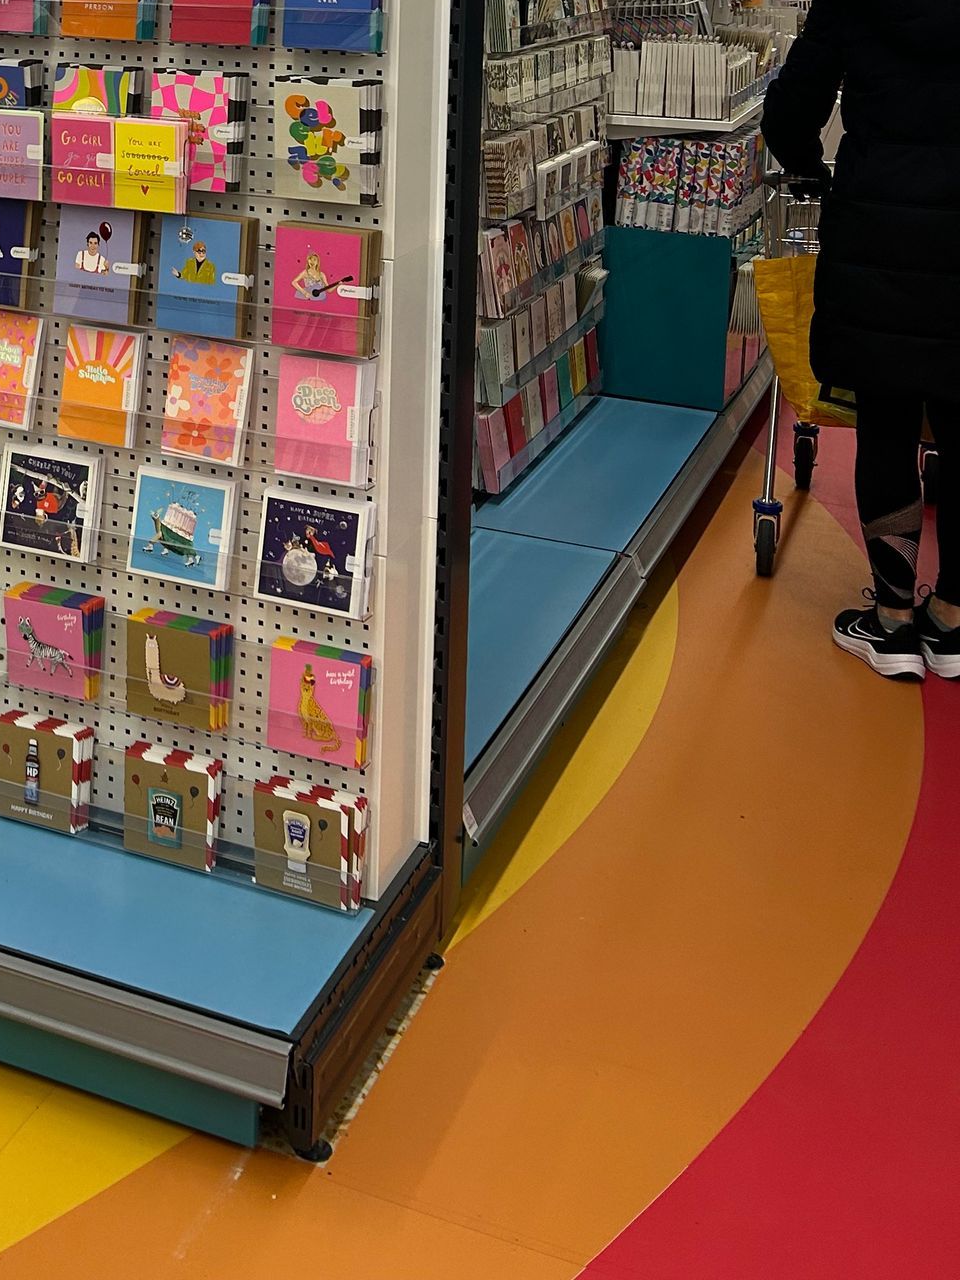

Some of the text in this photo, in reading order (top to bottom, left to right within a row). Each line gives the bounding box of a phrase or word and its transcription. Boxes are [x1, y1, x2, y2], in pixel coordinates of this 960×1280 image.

[84, 3, 114, 12] PERSON
[0, 122, 23, 136] YOU
[61, 130, 77, 146] Go
[128, 136, 162, 148] You are
[2, 140, 20, 152] ARE
[57, 170, 73, 184] GO
[85, 365, 108, 375] Hello
[78, 370, 116, 384] Sunshine
[298, 384, 336, 399] Disco
[292, 395, 341, 414] Queen
[28, 457, 51, 470] CHEERS
[61, 466, 77, 481] YOU!
[290, 505, 305, 514] HAVE
[56, 614, 78, 624] birthday
[330, 676, 353, 690] birthday
[26, 767, 39, 777] HP
[155, 796, 175, 807] HEINZ
[10, 804, 54, 820] HAPPY BIRTHDAY
[155, 814, 175, 826] BEAN
